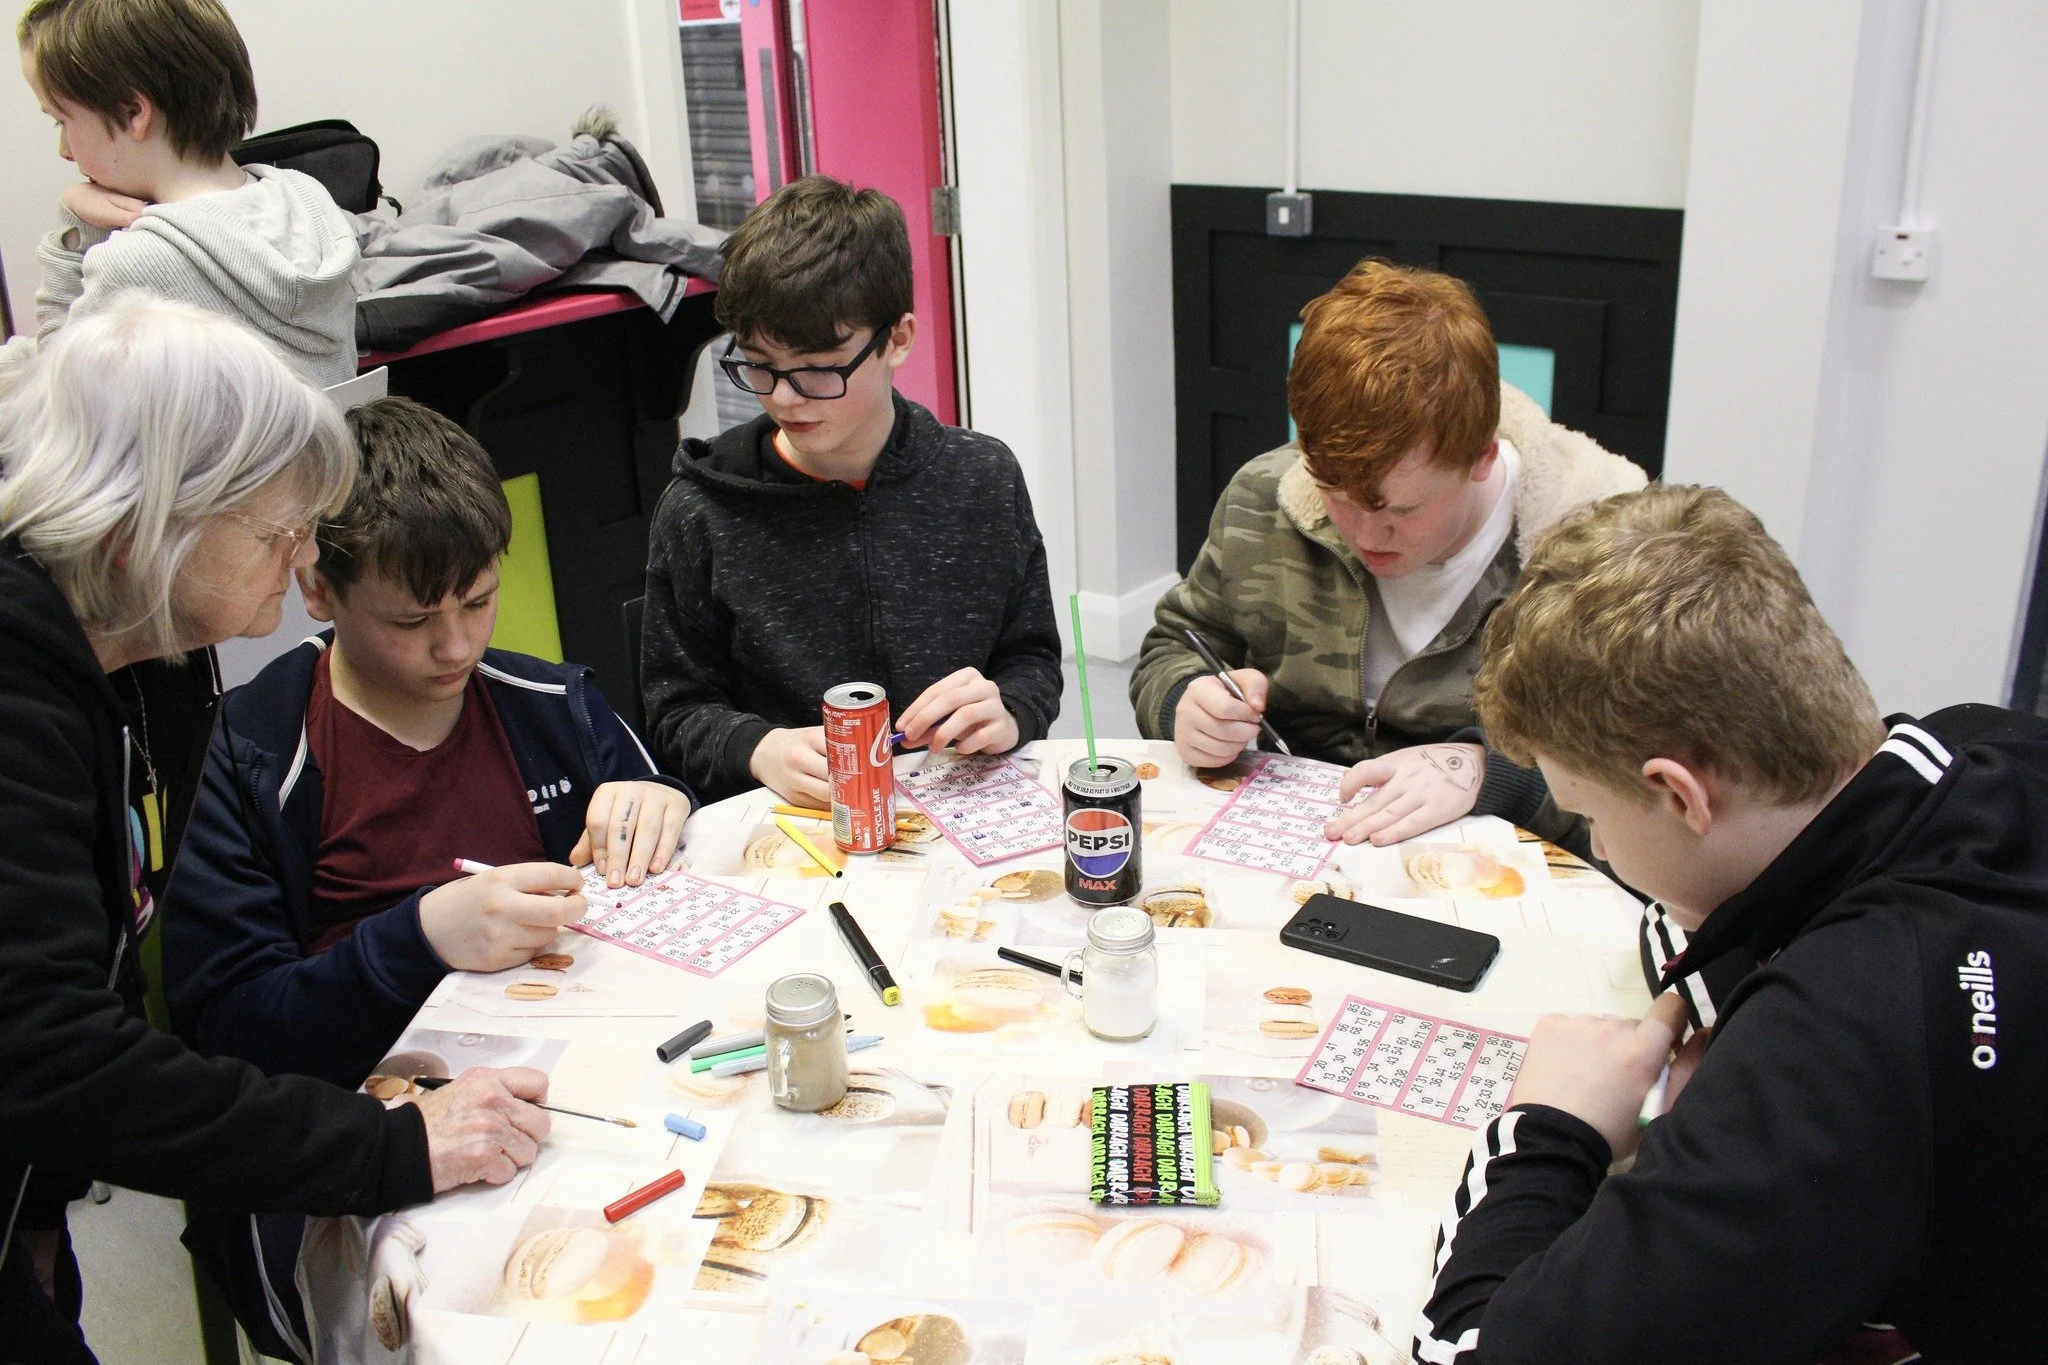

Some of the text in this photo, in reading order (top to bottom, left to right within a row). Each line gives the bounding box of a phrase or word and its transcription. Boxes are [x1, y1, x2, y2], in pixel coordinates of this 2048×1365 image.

[872, 788, 884, 847] RECYCLE ME
[1068, 829, 1130, 850] PEPSI
[1079, 878, 1117, 890] MAX
[1360, 1008, 1373, 1016] 87
[1354, 1017, 1368, 1026] 73
[1419, 1021, 1432, 1030] 90
[1350, 1026, 1363, 1034] 68
[1414, 1031, 1427, 1039] 71
[1452, 1029, 1466, 1038] 81
[1314, 1060, 1328, 1069] 20
[1338, 1023, 1349, 1032] 66
[1347, 1004, 1360, 1013] 85
[1396, 1036, 1409, 1046] 60
[1434, 1035, 1448, 1044] 76
[1466, 1032, 1479, 1041] 86
[1341, 1066, 1355, 1076] 23
[1352, 1047, 1366, 1056] 49
[1359, 1038, 1370, 1047] 56
[1368, 1020, 1381, 1028] 75
[1409, 1040, 1423, 1049] 69
[1357, 1081, 1371, 1089] 18
[1367, 1062, 1380, 1071] 34
[1377, 1043, 1391, 1052] 53
[1392, 1015, 1406, 1024] 83
[1391, 1046, 1404, 1055] 54
[1444, 1048, 1457, 1057] 63
[1333, 1054, 1347, 1063] 30
[1386, 1056, 1400, 1065] 43
[1425, 1054, 1438, 1064] 51
[1510, 1052, 1523, 1062] 77
[1453, 1061, 1466, 1070] 55
[1506, 1062, 1519, 1072] 67
[1323, 1072, 1336, 1080] 13
[1394, 1068, 1408, 1078] 38
[1434, 1067, 1447, 1076] 44
[1448, 1071, 1462, 1080] 45
[1456, 1106, 1470, 1114] 12
[1469, 1075, 1483, 1085] 40
[1478, 1056, 1491, 1065] 65
[1486, 1037, 1500, 1046] 80
[1475, 1040, 1513, 1109] 22 33 48 72 89
[1375, 1075, 1389, 1084] 27
[1415, 1074, 1429, 1083] 31
[1429, 1077, 1443, 1087] 36
[1502, 1072, 1515, 1082] 57
[1389, 1078, 1403, 1088] 29
[1410, 1083, 1424, 1093] 21
[1420, 1097, 1434, 1105] 10
[1435, 1101, 1448, 1109] 11
[1092, 1090, 1107, 1135] DARRAGH
[1132, 1088, 1151, 1134] DARRAGH
[1489, 1102, 1503, 1113] 26
[1109, 1113, 1128, 1157] DARRAGH
[1155, 1113, 1176, 1157] DARRAGH
[1091, 1137, 1106, 1185] DARRAGH
[1133, 1137, 1152, 1182] DARRAGH
